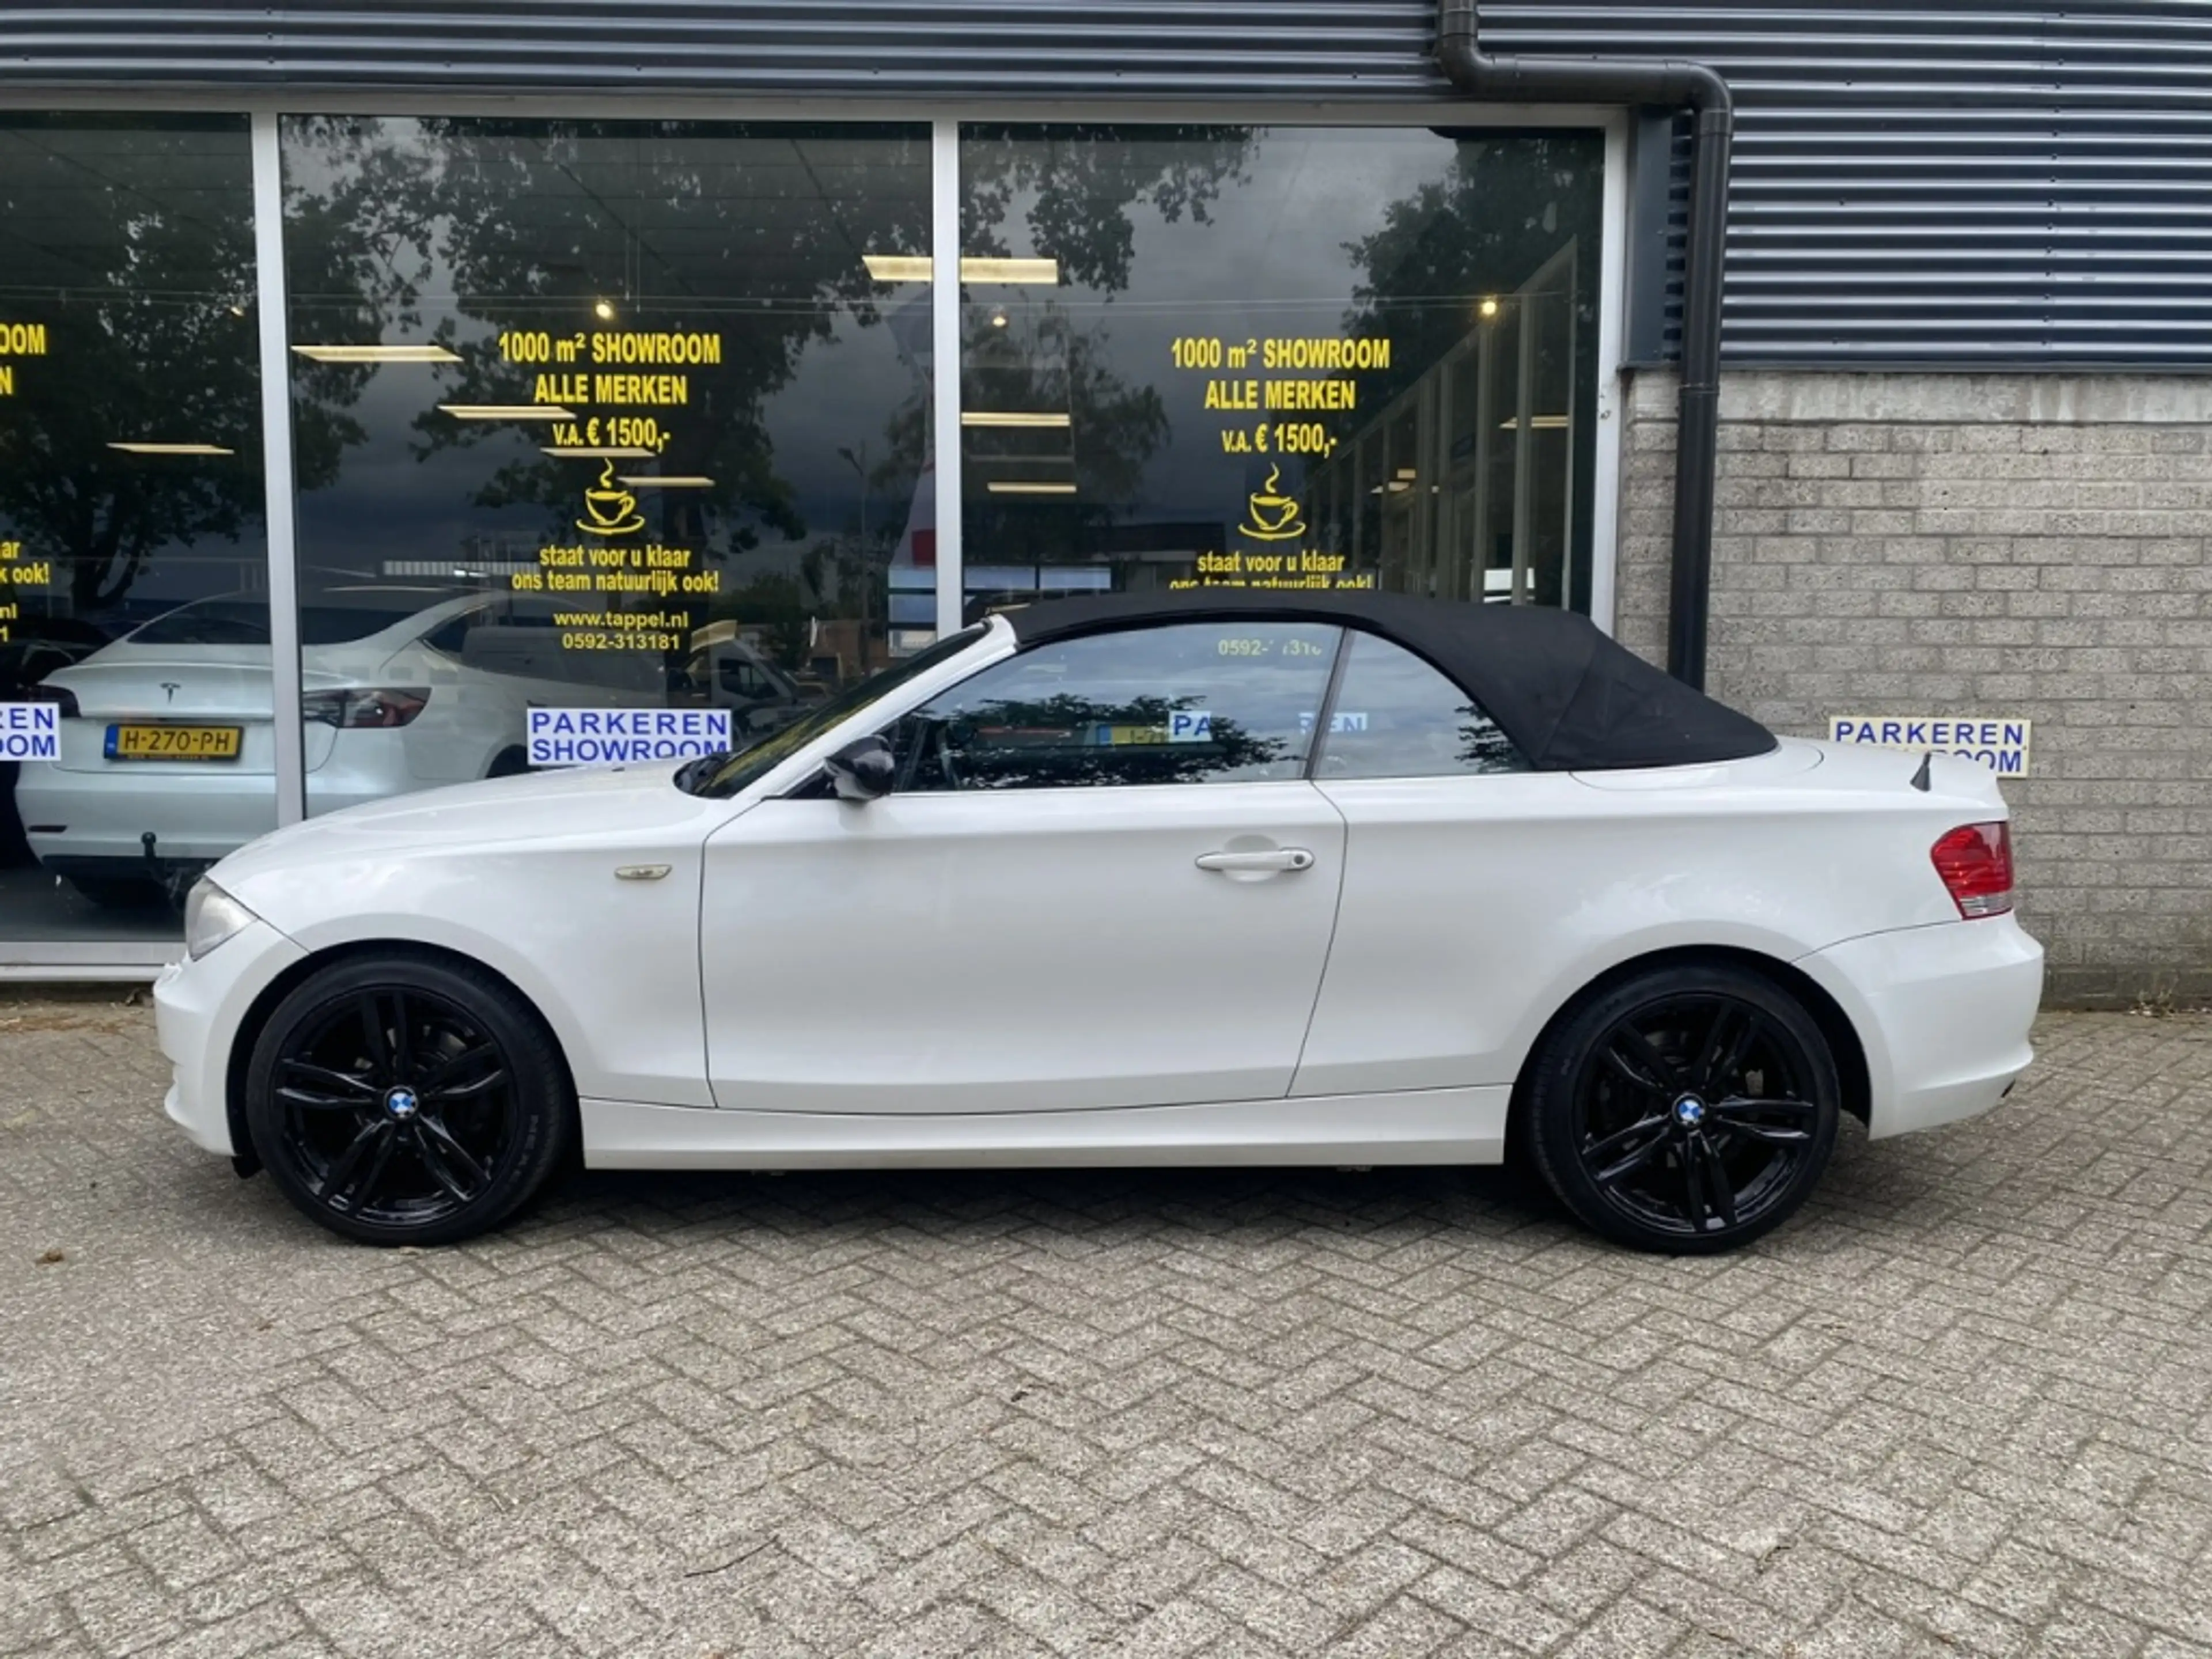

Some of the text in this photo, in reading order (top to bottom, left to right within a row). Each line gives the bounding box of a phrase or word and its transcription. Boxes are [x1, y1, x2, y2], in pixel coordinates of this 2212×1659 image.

[499, 332, 550, 362] 1000
[592, 333, 721, 364] SHOWROOM
[1172, 338, 1221, 368] 1000
[1263, 339, 1390, 369] SHOWROOM
[535, 374, 687, 404] ALLE MERKEN
[1205, 380, 1355, 410] ALLE MERKEN
[586, 418, 600, 446] €
[1256, 424, 1268, 453] €
[540, 545, 691, 568] staat voor u klaar
[1197, 550, 1345, 572] staat voor u klaar
[12, 561, 50, 585] ook!
[512, 571, 719, 596] ons team natuurlijk ook!
[554, 612, 688, 630] www.tappel.nl
[563, 634, 680, 649] 0592-313181
[532, 712, 726, 735] PARKEREN
[1835, 722, 2023, 745] PARKEREN
[124, 730, 230, 751] H-270-PH
[532, 739, 727, 761] SHOWROOM
